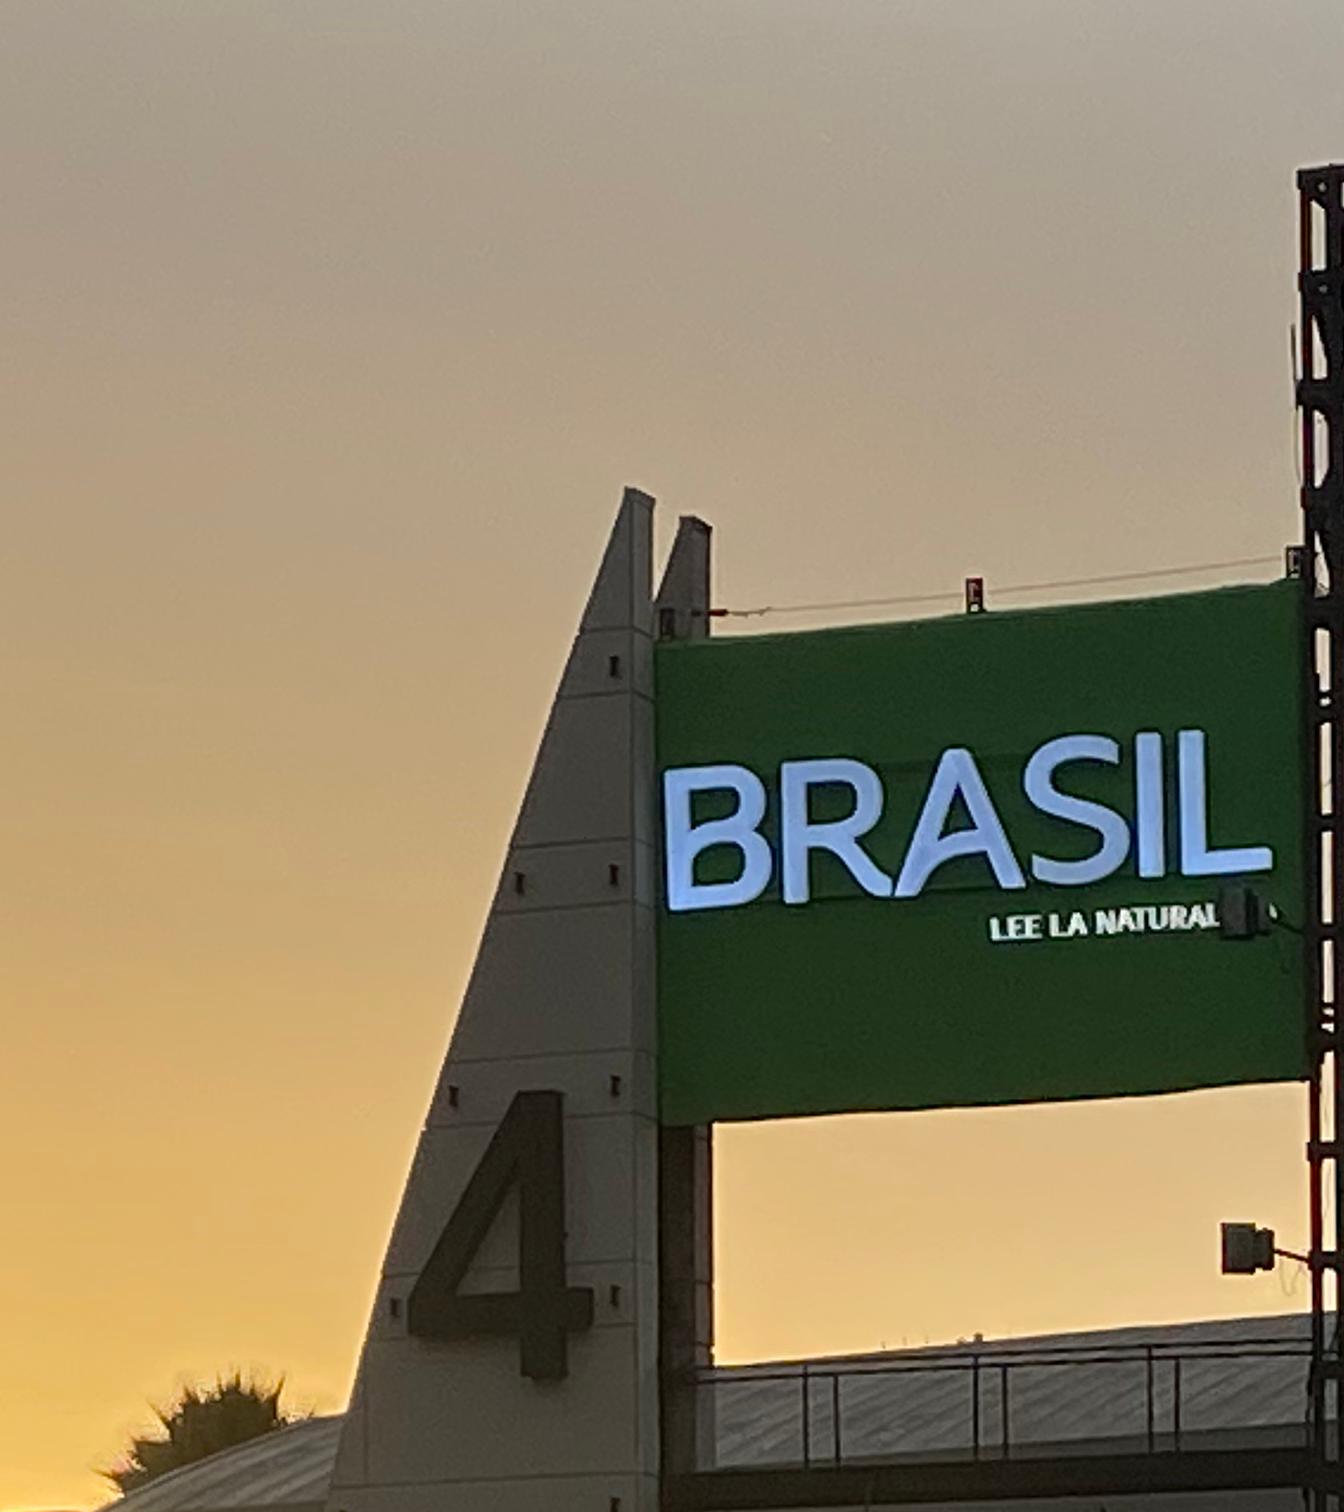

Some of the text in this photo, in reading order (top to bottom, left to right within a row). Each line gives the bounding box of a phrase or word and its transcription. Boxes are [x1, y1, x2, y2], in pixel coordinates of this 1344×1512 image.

[662, 729, 1273, 912] BRASIL
[989, 902, 1277, 941] LEE LA NATURAL
[406, 1090, 595, 1381] 4
